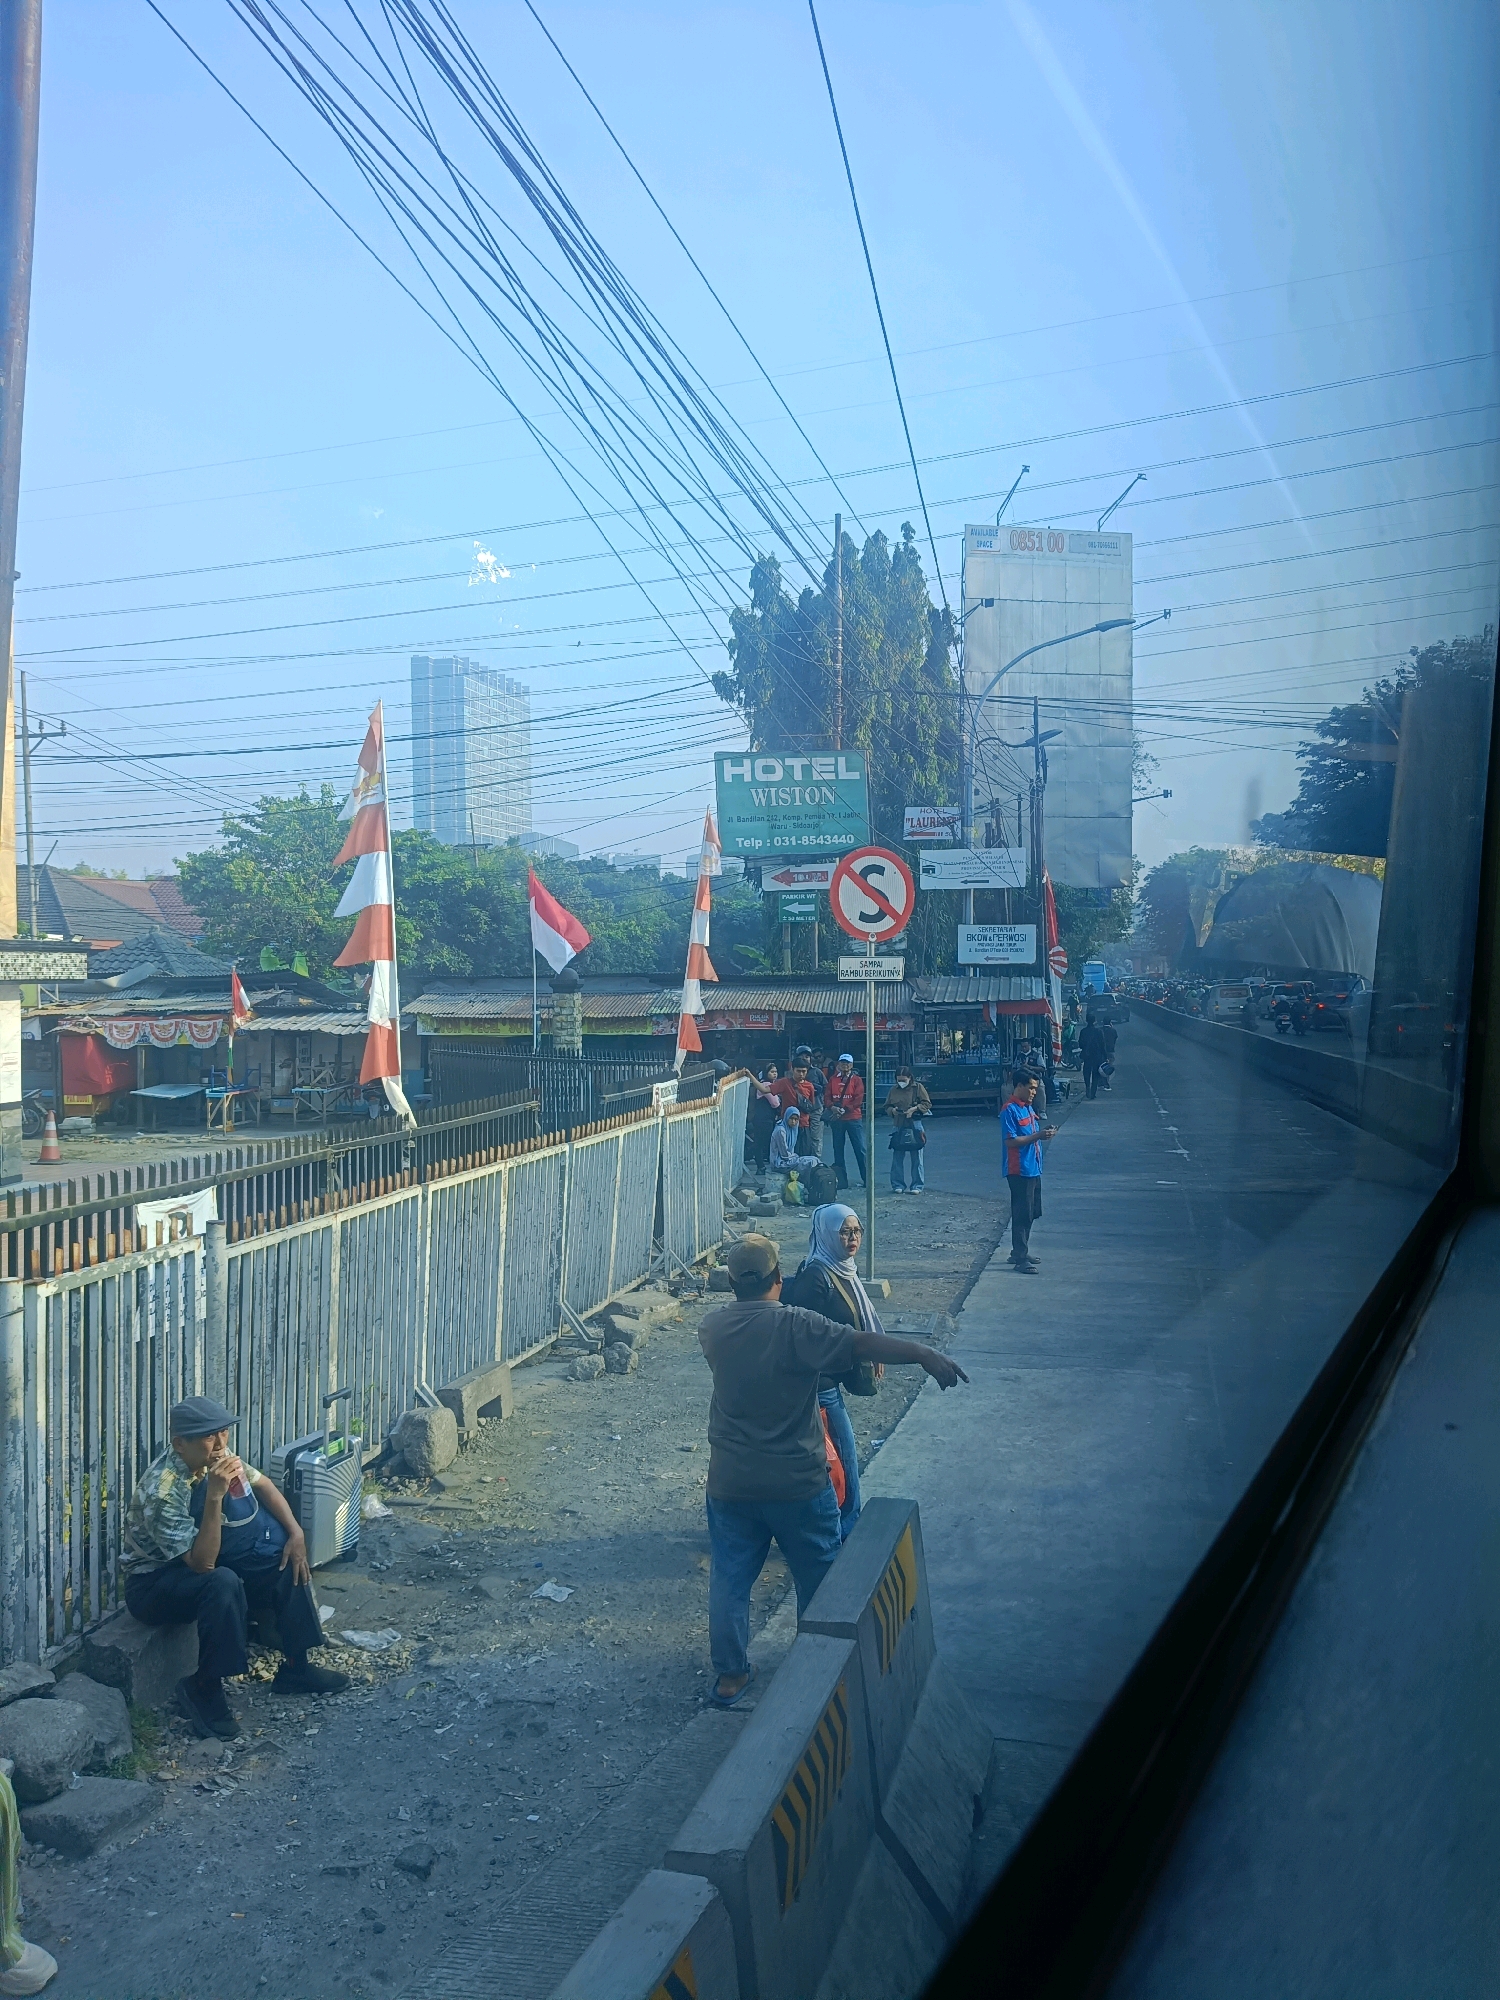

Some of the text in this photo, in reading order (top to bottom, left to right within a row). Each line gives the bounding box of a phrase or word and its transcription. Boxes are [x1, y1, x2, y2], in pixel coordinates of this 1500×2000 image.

[970, 528, 998, 537] AVAILABLE
[976, 540, 993, 549] SPACE
[1009, 529, 1044, 552] 0851
[723, 757, 861, 783] HOTEL
[750, 786, 837, 807] WISTON
[770, 823, 788, 831] Waru
[735, 837, 763, 850] Telp
[773, 834, 855, 847] 031-8543440
[859, 960, 883, 969] SAMPAI
[840, 968, 902, 978] RAMBU BERIKUTNYA
